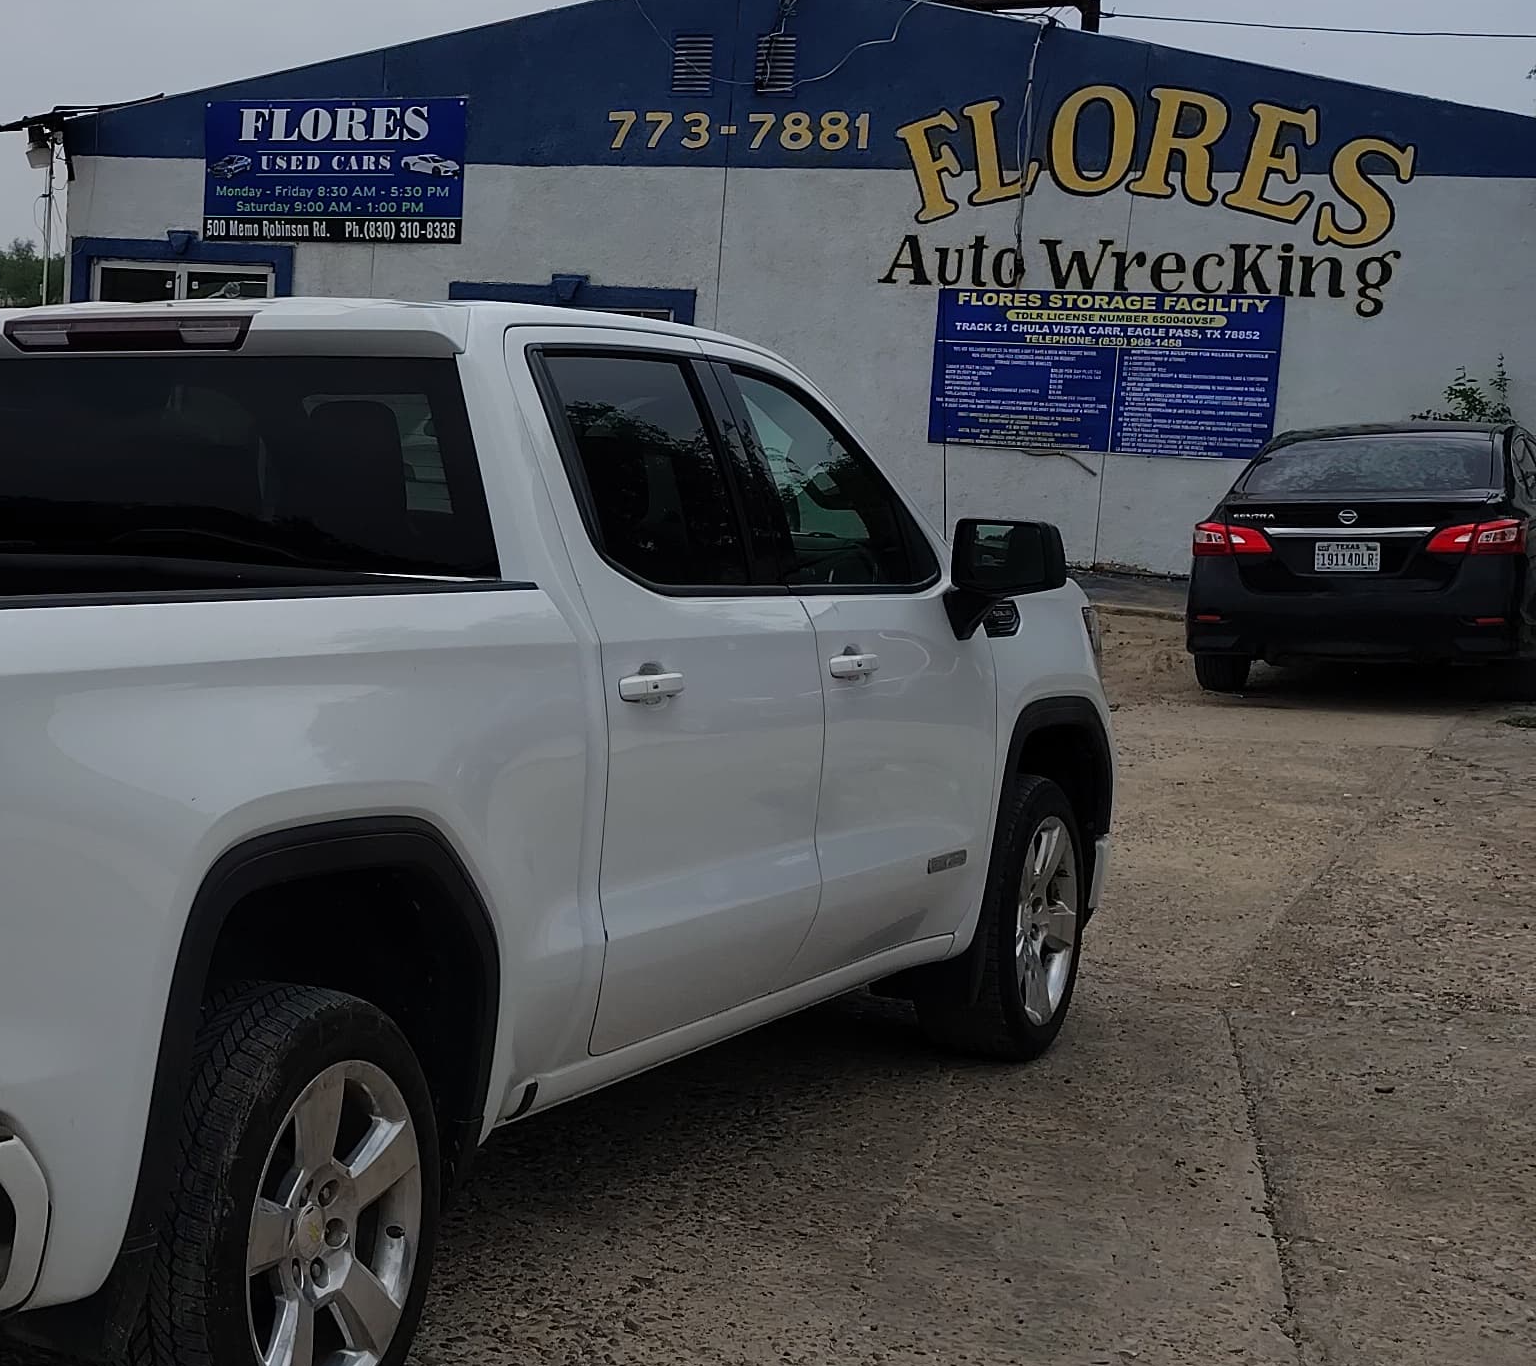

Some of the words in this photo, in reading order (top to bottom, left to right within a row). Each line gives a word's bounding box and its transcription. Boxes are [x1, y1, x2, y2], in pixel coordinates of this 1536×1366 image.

[239, 106, 430, 142] FLORES
[607, 109, 872, 152] 773-7881
[261, 155, 321, 172] USED
[332, 155, 392, 171] CARS
[896, 84, 1417, 248] FLORES
[216, 186, 262, 198] Monday
[275, 186, 314, 198] Friday
[317, 186, 348, 197] 8:30
[352, 186, 376, 197] AM
[390, 186, 422, 197] 5:30
[427, 186, 449, 197] PM
[236, 201, 290, 213] Saturday
[294, 201, 324, 212] 9:00
[328, 201, 352, 212] AM
[367, 202, 397, 213] 1:00
[402, 202, 424, 213] PM
[206, 219, 226, 236] 500
[229, 220, 259, 236] Memo
[262, 220, 309, 239] Robinson
[313, 221, 330, 237] Rd.
[399, 221, 456, 239] 310-8336
[878, 235, 1026, 288] Auto
[957, 291, 1042, 307] FLORES
[1048, 293, 1157, 310] STORAGE
[1164, 296, 1270, 313] FACILITY
[1014, 312, 1044, 321] TDLR
[1047, 313, 1096, 322] LICENSE
[1098, 314, 1149, 323] NUMBER
[955, 322, 992, 332] TRACK
[995, 323, 1008, 332] 21
[1011, 323, 1050, 334] CHULA
[1052, 325, 1086, 334] VISTA
[1127, 327, 1166, 337] EAGLE
[1168, 328, 1202, 339] PASS,
[1205, 329, 1222, 339] TX
[1024, 334, 1096, 345] TELEPHONE:
[1098, 336, 1127, 348] (830)
[1130, 337, 1182, 348] 968-1458
[1320, 552, 1374, 567] 19114DLR
